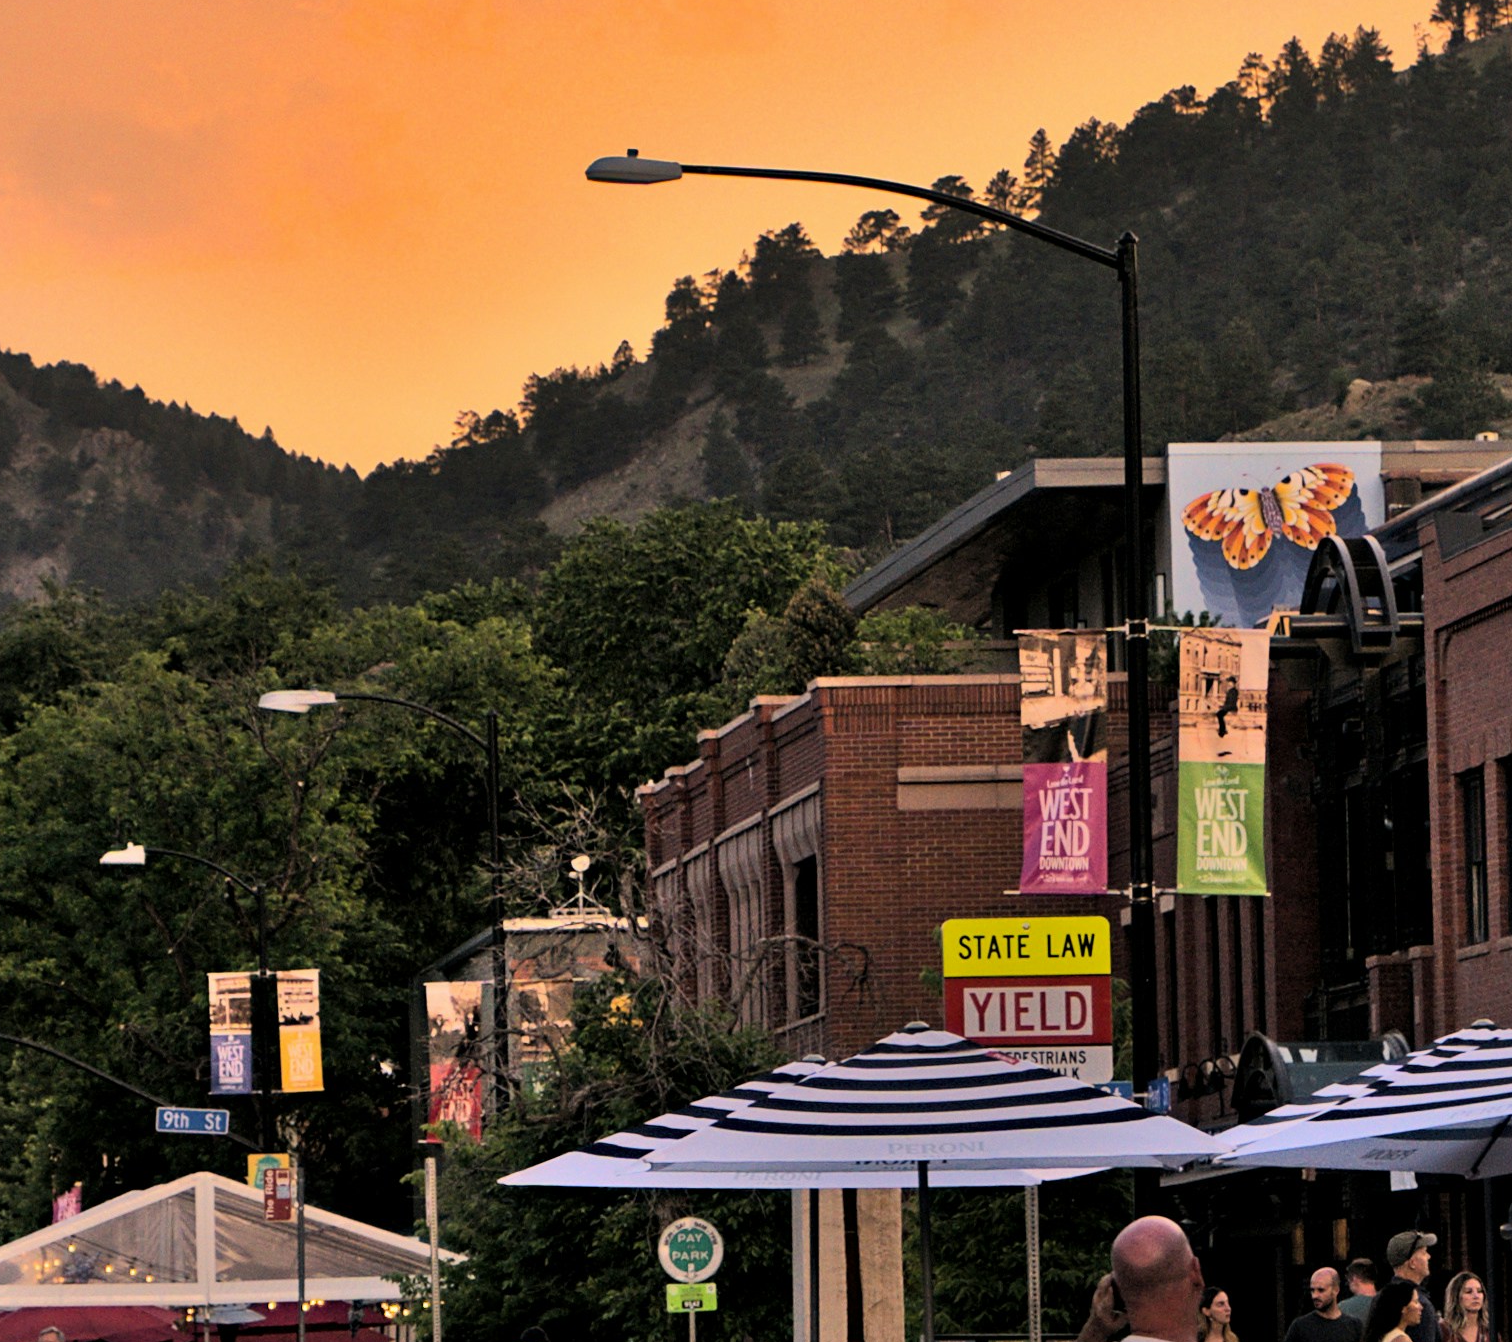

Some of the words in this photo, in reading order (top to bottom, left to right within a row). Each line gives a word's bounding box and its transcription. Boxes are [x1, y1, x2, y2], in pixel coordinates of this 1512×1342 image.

[1038, 788, 1093, 821] WEST
[1194, 788, 1248, 821] WEST
[1040, 820, 1090, 856] END
[1196, 820, 1247, 857] END
[1039, 857, 1089, 871] DOWNTOWN
[1196, 857, 1248, 871] DOWNTOWN
[959, 935, 1031, 959] STATE
[1047, 934, 1095, 958] LAW
[970, 991, 1088, 1032] YIELD
[217, 1045, 244, 1060] WEST
[287, 1043, 314, 1058] WEST
[998, 1050, 1087, 1065] EDESTRIANS
[219, 1060, 244, 1077] END
[289, 1059, 315, 1076] END
[163, 1111, 190, 1129] 9th
[204, 1112, 222, 1130] St
[888, 1141, 985, 1155] PERONI
[265, 1169, 274, 1195] Ride
[266, 1199, 275, 1219] The
[677, 1233, 703, 1243] PAY
[672, 1250, 709, 1261] PARK
